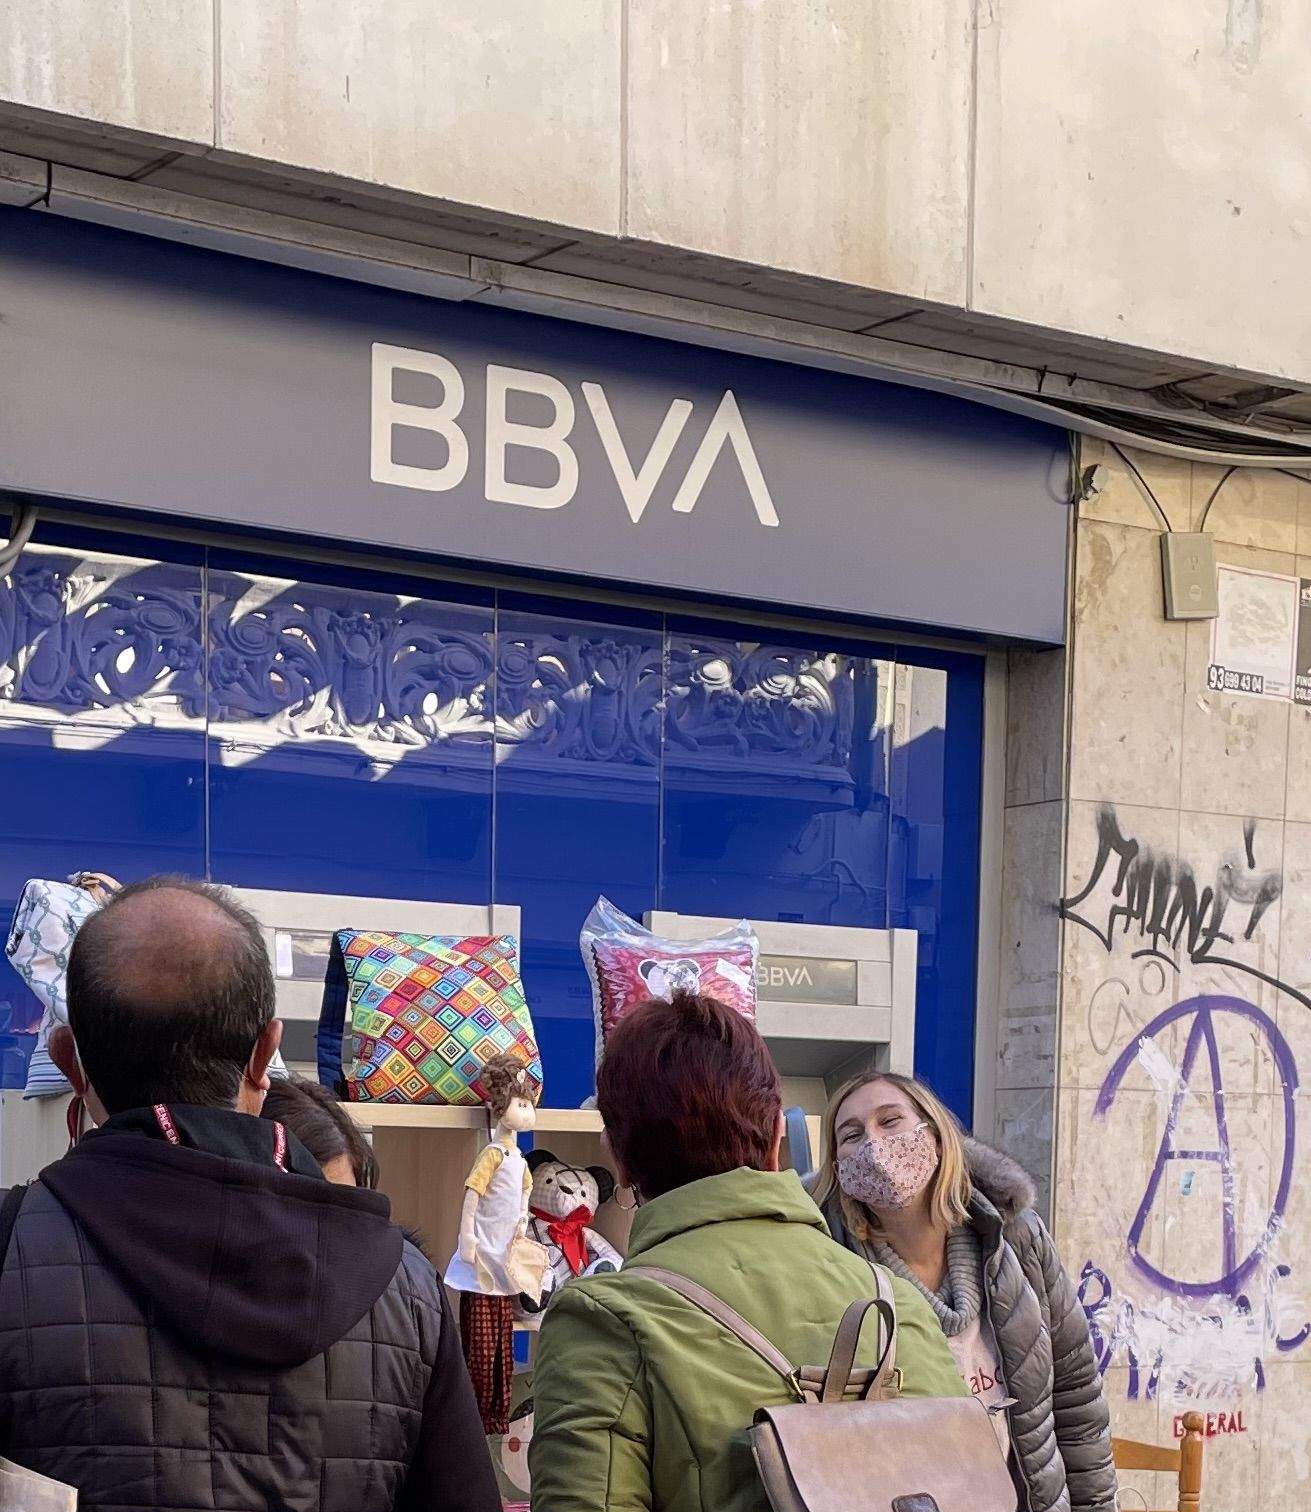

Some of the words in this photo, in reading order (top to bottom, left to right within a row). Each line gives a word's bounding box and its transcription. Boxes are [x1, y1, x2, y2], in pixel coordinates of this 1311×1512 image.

[371, 342, 779, 527] BBVA
[1209, 666, 1225, 690] 93
[1174, 1411, 1247, 1437] GERAL
